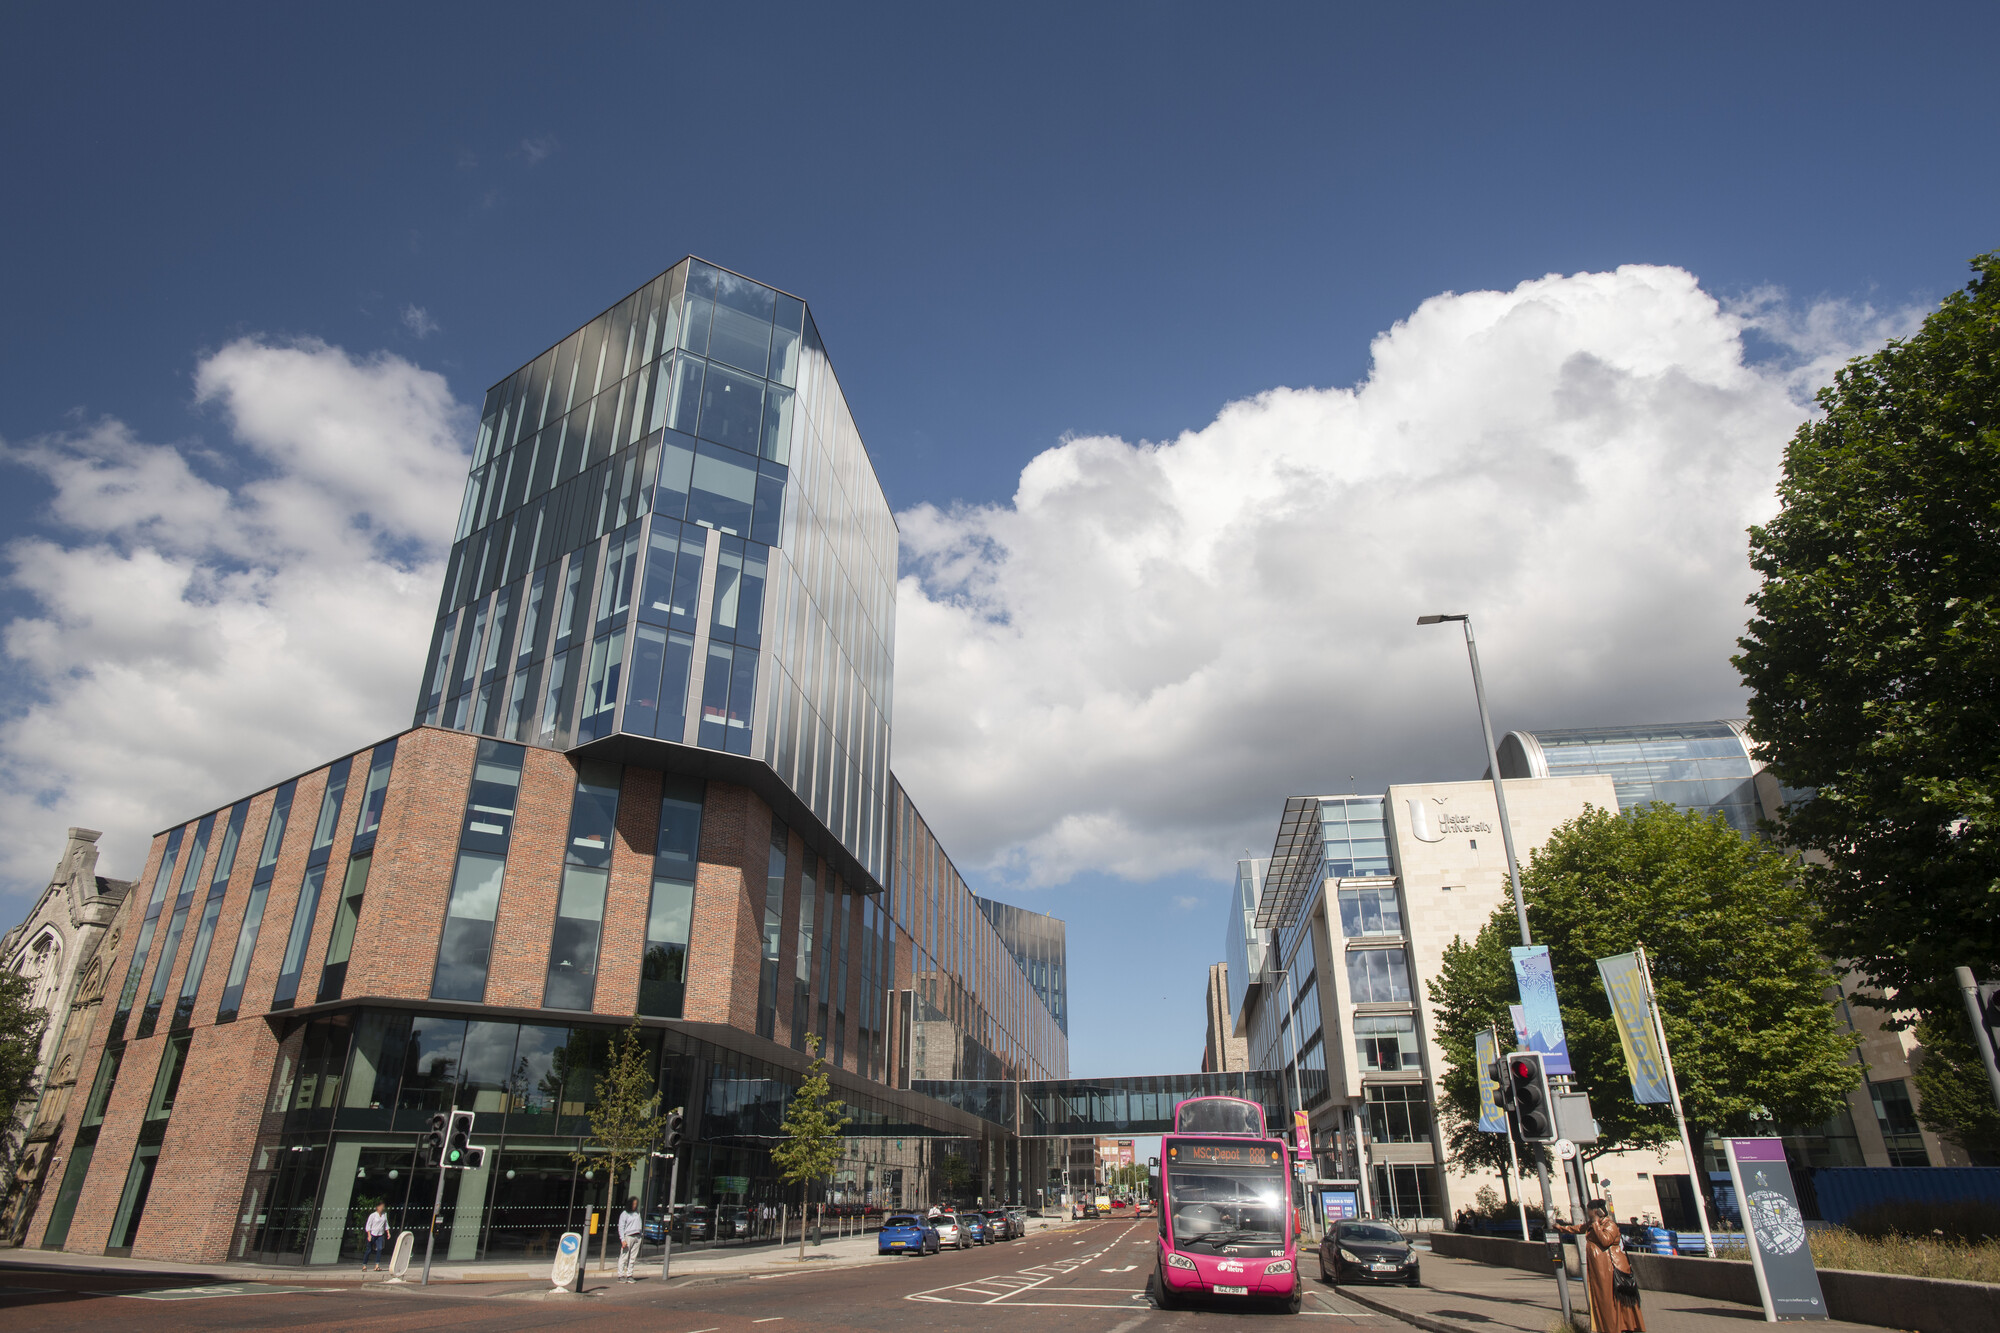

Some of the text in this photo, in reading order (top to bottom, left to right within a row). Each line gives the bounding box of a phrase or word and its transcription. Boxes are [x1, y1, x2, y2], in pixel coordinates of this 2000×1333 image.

[1438, 814, 1471, 824] Ulster
[1439, 822, 1493, 834] University
[1194, 1147, 1266, 1164] MSC Depot 888
[1227, 1265, 1244, 1273] Metro
